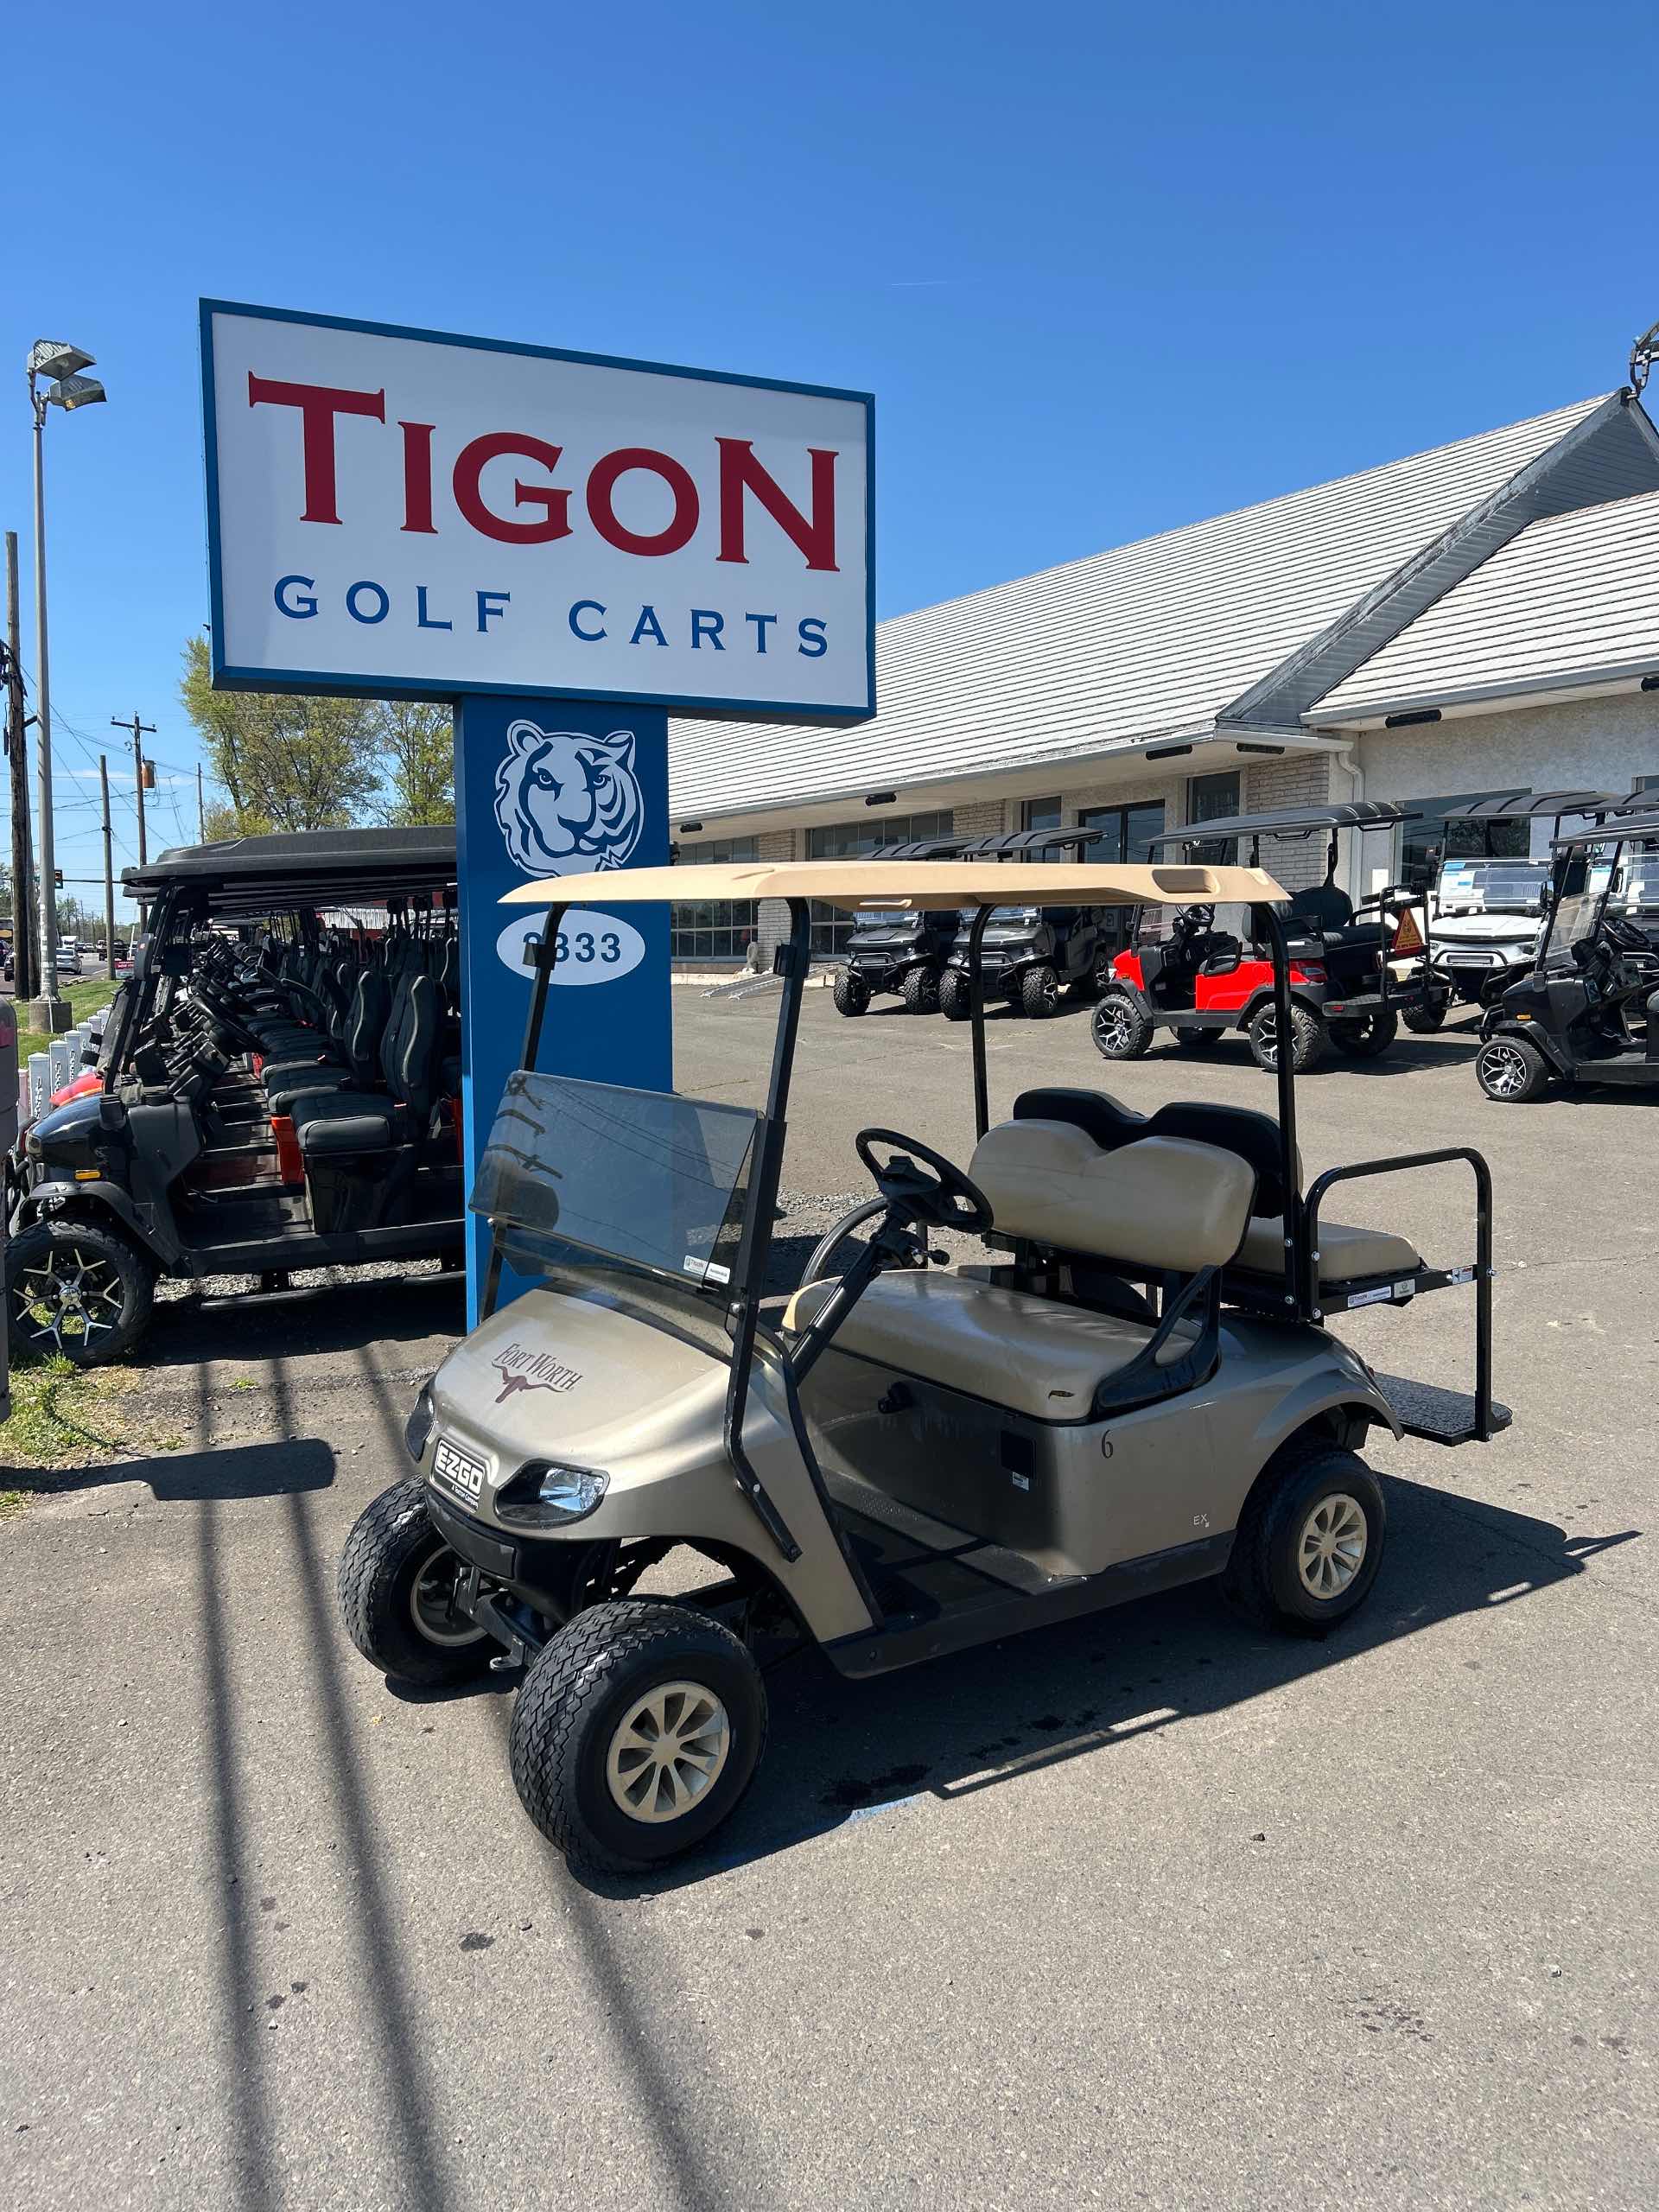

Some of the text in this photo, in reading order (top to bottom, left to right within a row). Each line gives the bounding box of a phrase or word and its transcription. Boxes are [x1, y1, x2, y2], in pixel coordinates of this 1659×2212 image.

[248, 371, 840, 572] TIGON
[274, 574, 828, 658] GOLF CARTS
[494, 1343, 583, 1390] FORT WORTH
[1101, 1428, 1114, 1459] 6
